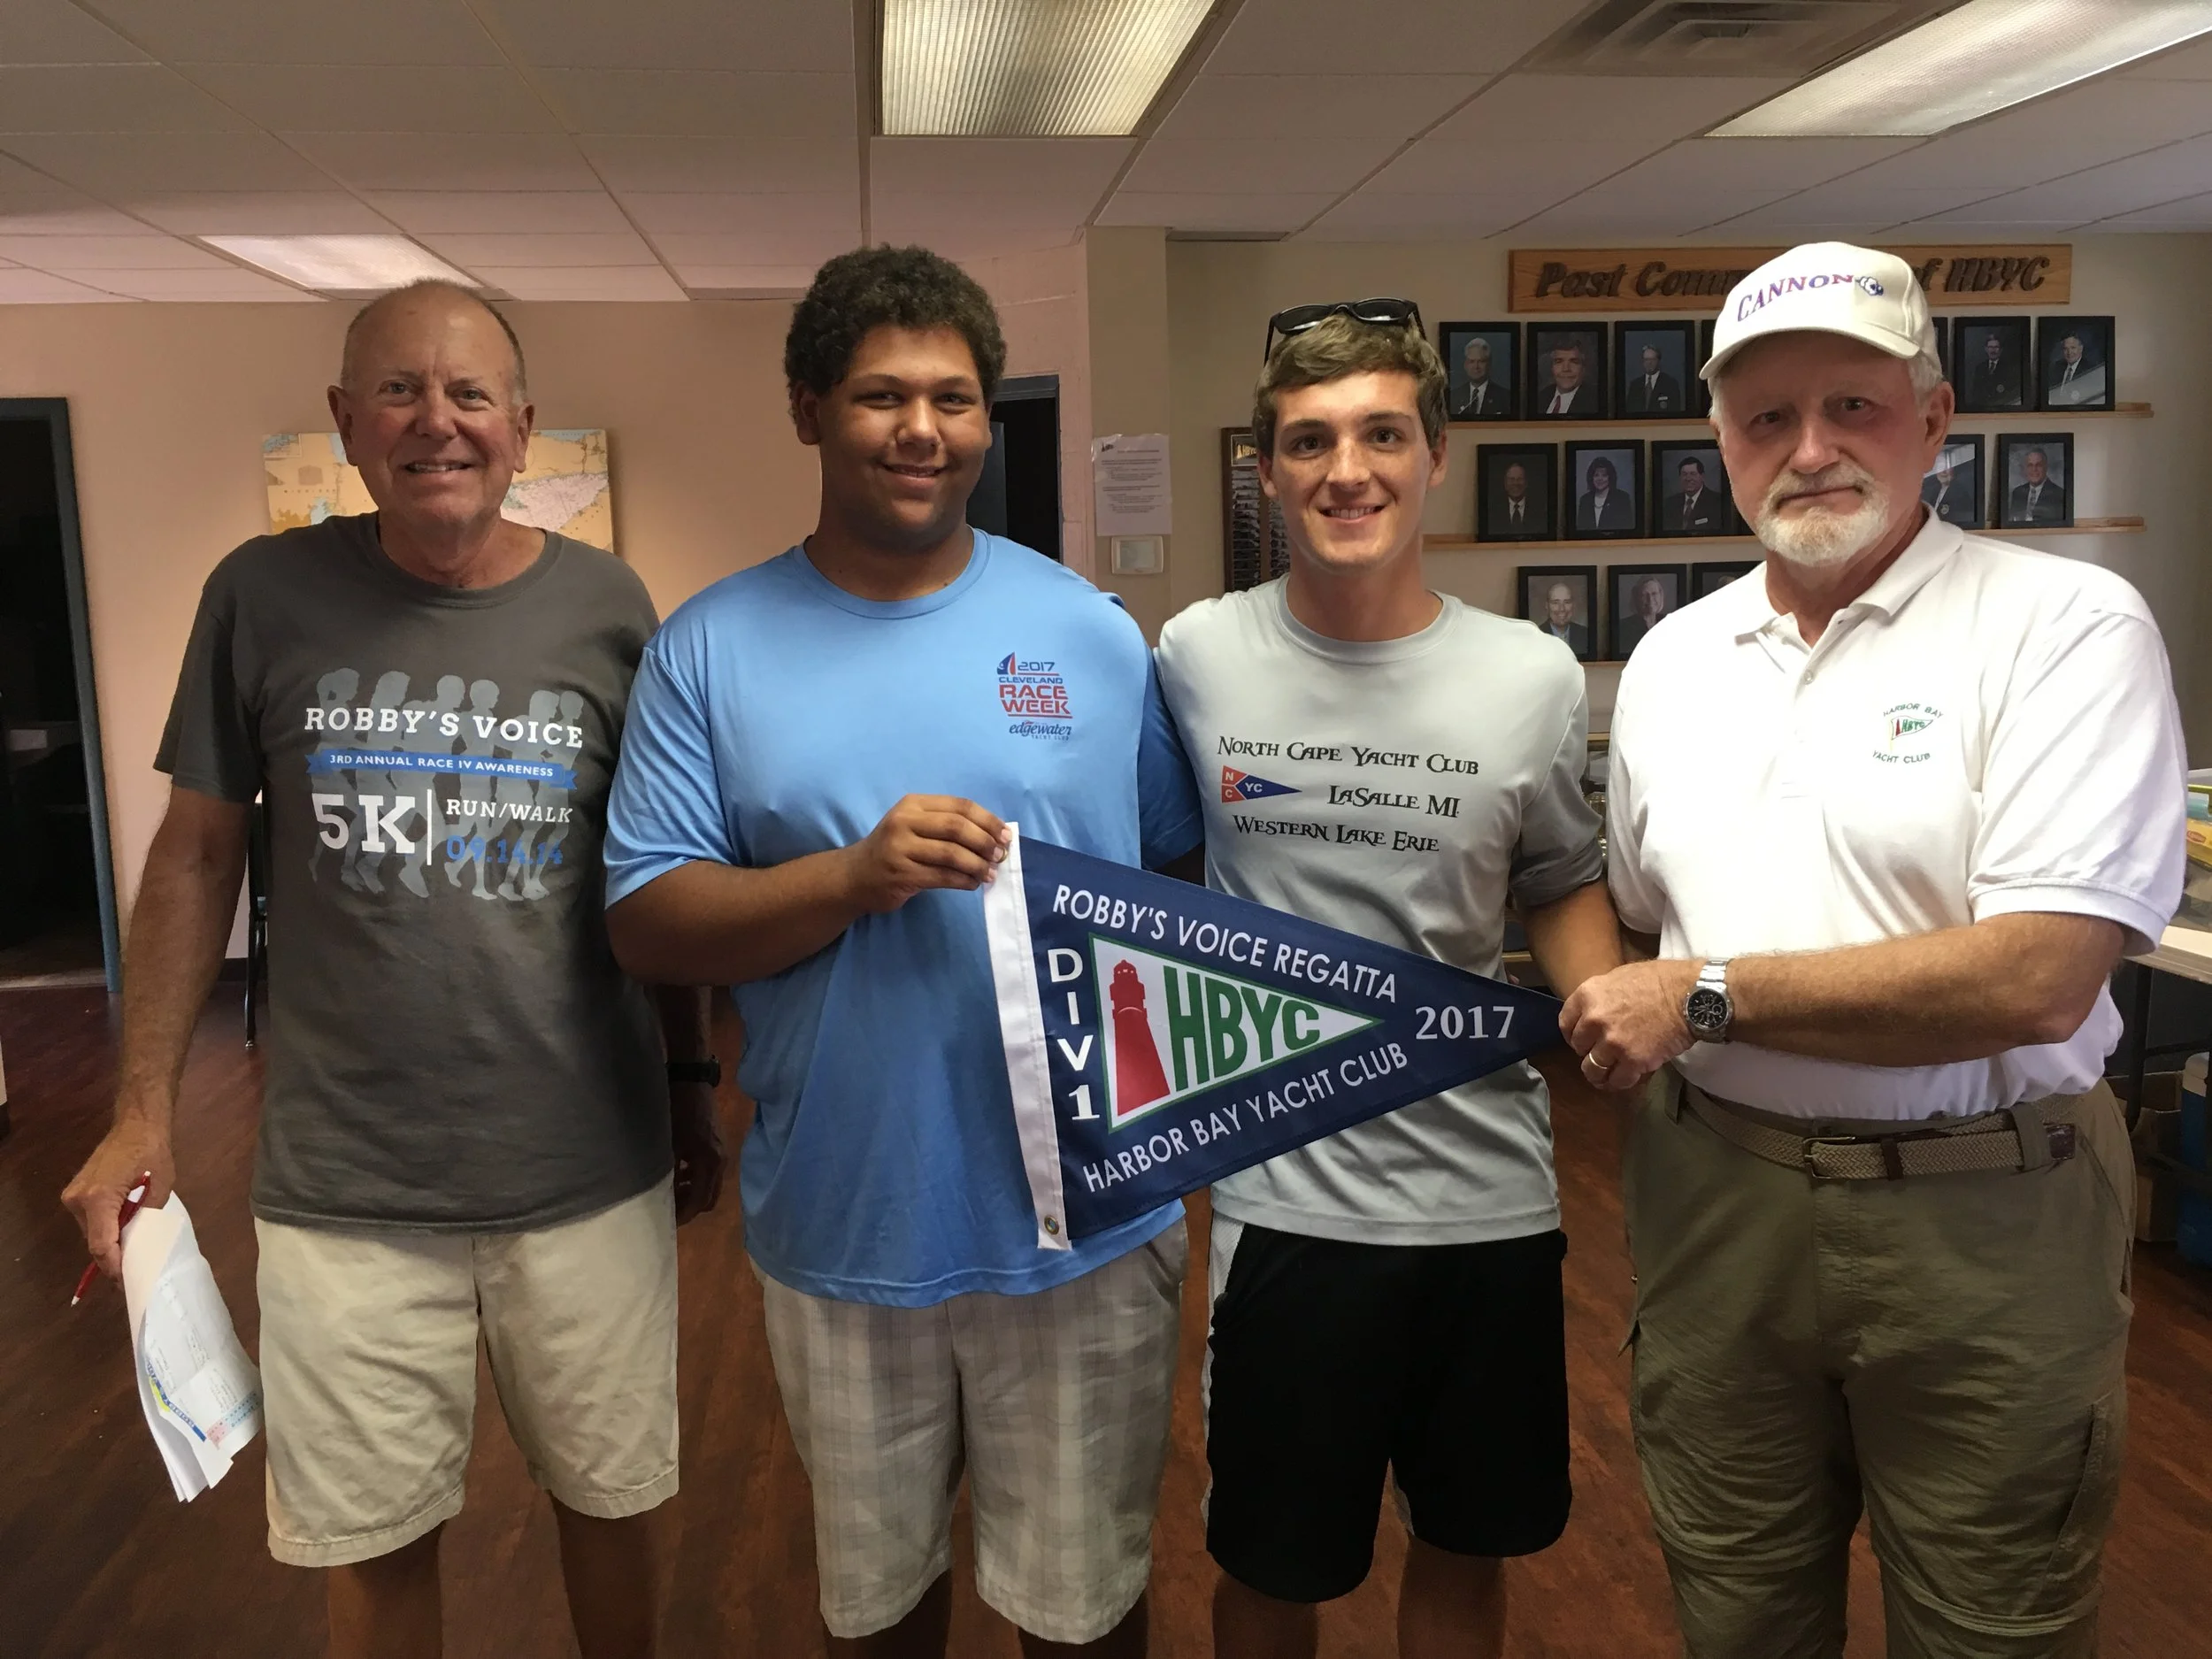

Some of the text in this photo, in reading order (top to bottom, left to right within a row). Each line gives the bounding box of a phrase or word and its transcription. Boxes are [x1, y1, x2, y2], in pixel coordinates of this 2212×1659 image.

[1535, 262, 1628, 298] Past
[1943, 256, 2050, 292] HBYC
[1737, 273, 1855, 322] CANNON
[1018, 662, 1056, 672] 2017
[998, 684, 1069, 700] RACE
[1001, 699, 1071, 715] WEEK
[1901, 718, 1926, 733] HBYC
[1924, 706, 1944, 718] BAY
[304, 707, 584, 749] ROBBY'S VOICE
[1009, 721, 1072, 737] edgewater
[329, 754, 555, 778] 3RD ANNUAL RACE IV AWARENESS
[1217, 735, 1479, 775] NORTH CAPE YACHT CLUB
[1872, 749, 1931, 764] YACHT CLUB
[1245, 782, 1263, 794] YC
[311, 793, 416, 855] 5K
[445, 798, 574, 824] RUN/WALK
[1233, 814, 1440, 852] WESTERN LAKE ERIE
[1052, 884, 1399, 1004] ROBBY'S VOICE REGATTA
[1163, 965, 1322, 1093] HBYC
[1415, 1004, 1516, 1041] 2017
[1082, 1041, 1409, 1193] HARBOR BAY YACHT CLUB
